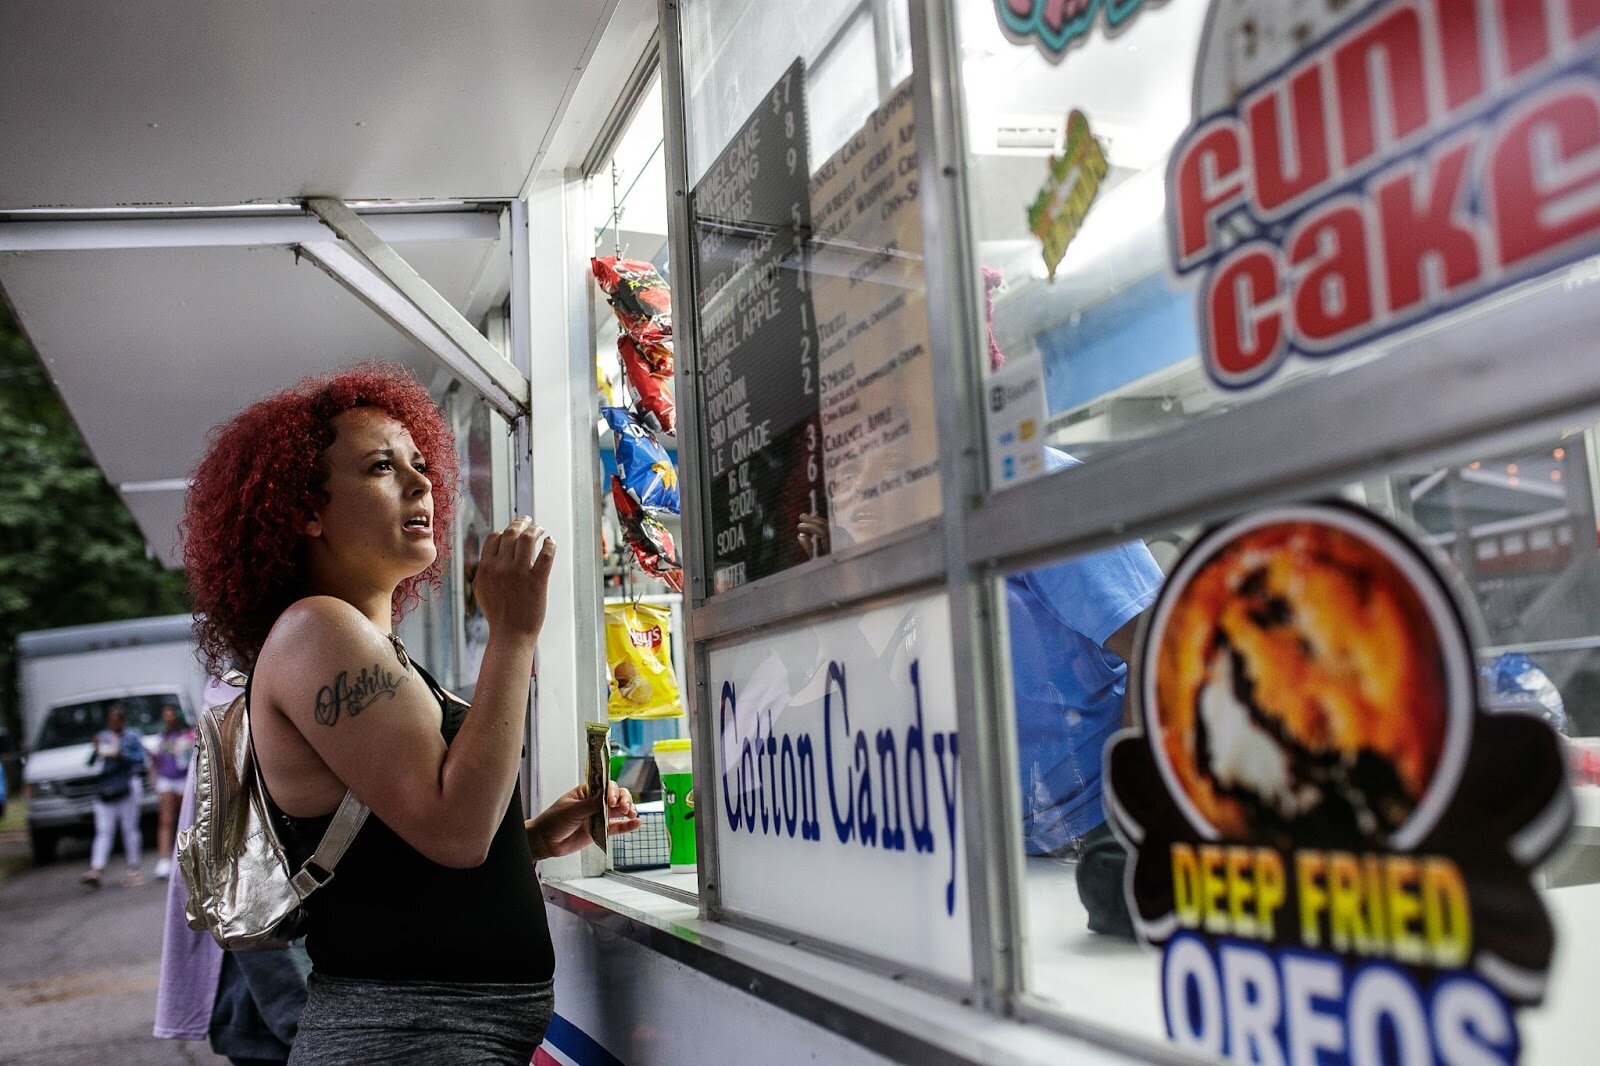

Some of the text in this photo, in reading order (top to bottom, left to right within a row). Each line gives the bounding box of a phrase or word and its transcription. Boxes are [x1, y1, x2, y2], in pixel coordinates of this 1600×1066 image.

[785, 110, 795, 139] 8
[729, 118, 761, 174] CAKE
[787, 147, 798, 176] 9
[742, 287, 781, 341] APPLE
[801, 303, 808, 330] 1
[801, 336, 811, 365] 2
[802, 366, 814, 395] 2
[807, 423, 816, 452] 3
[807, 454, 818, 482] 6
[717, 522, 747, 556] SODA
[809, 489, 818, 517] 1
[720, 658, 959, 918] Cotton Candy
[1170, 842, 1475, 968] DEEP FRIED
